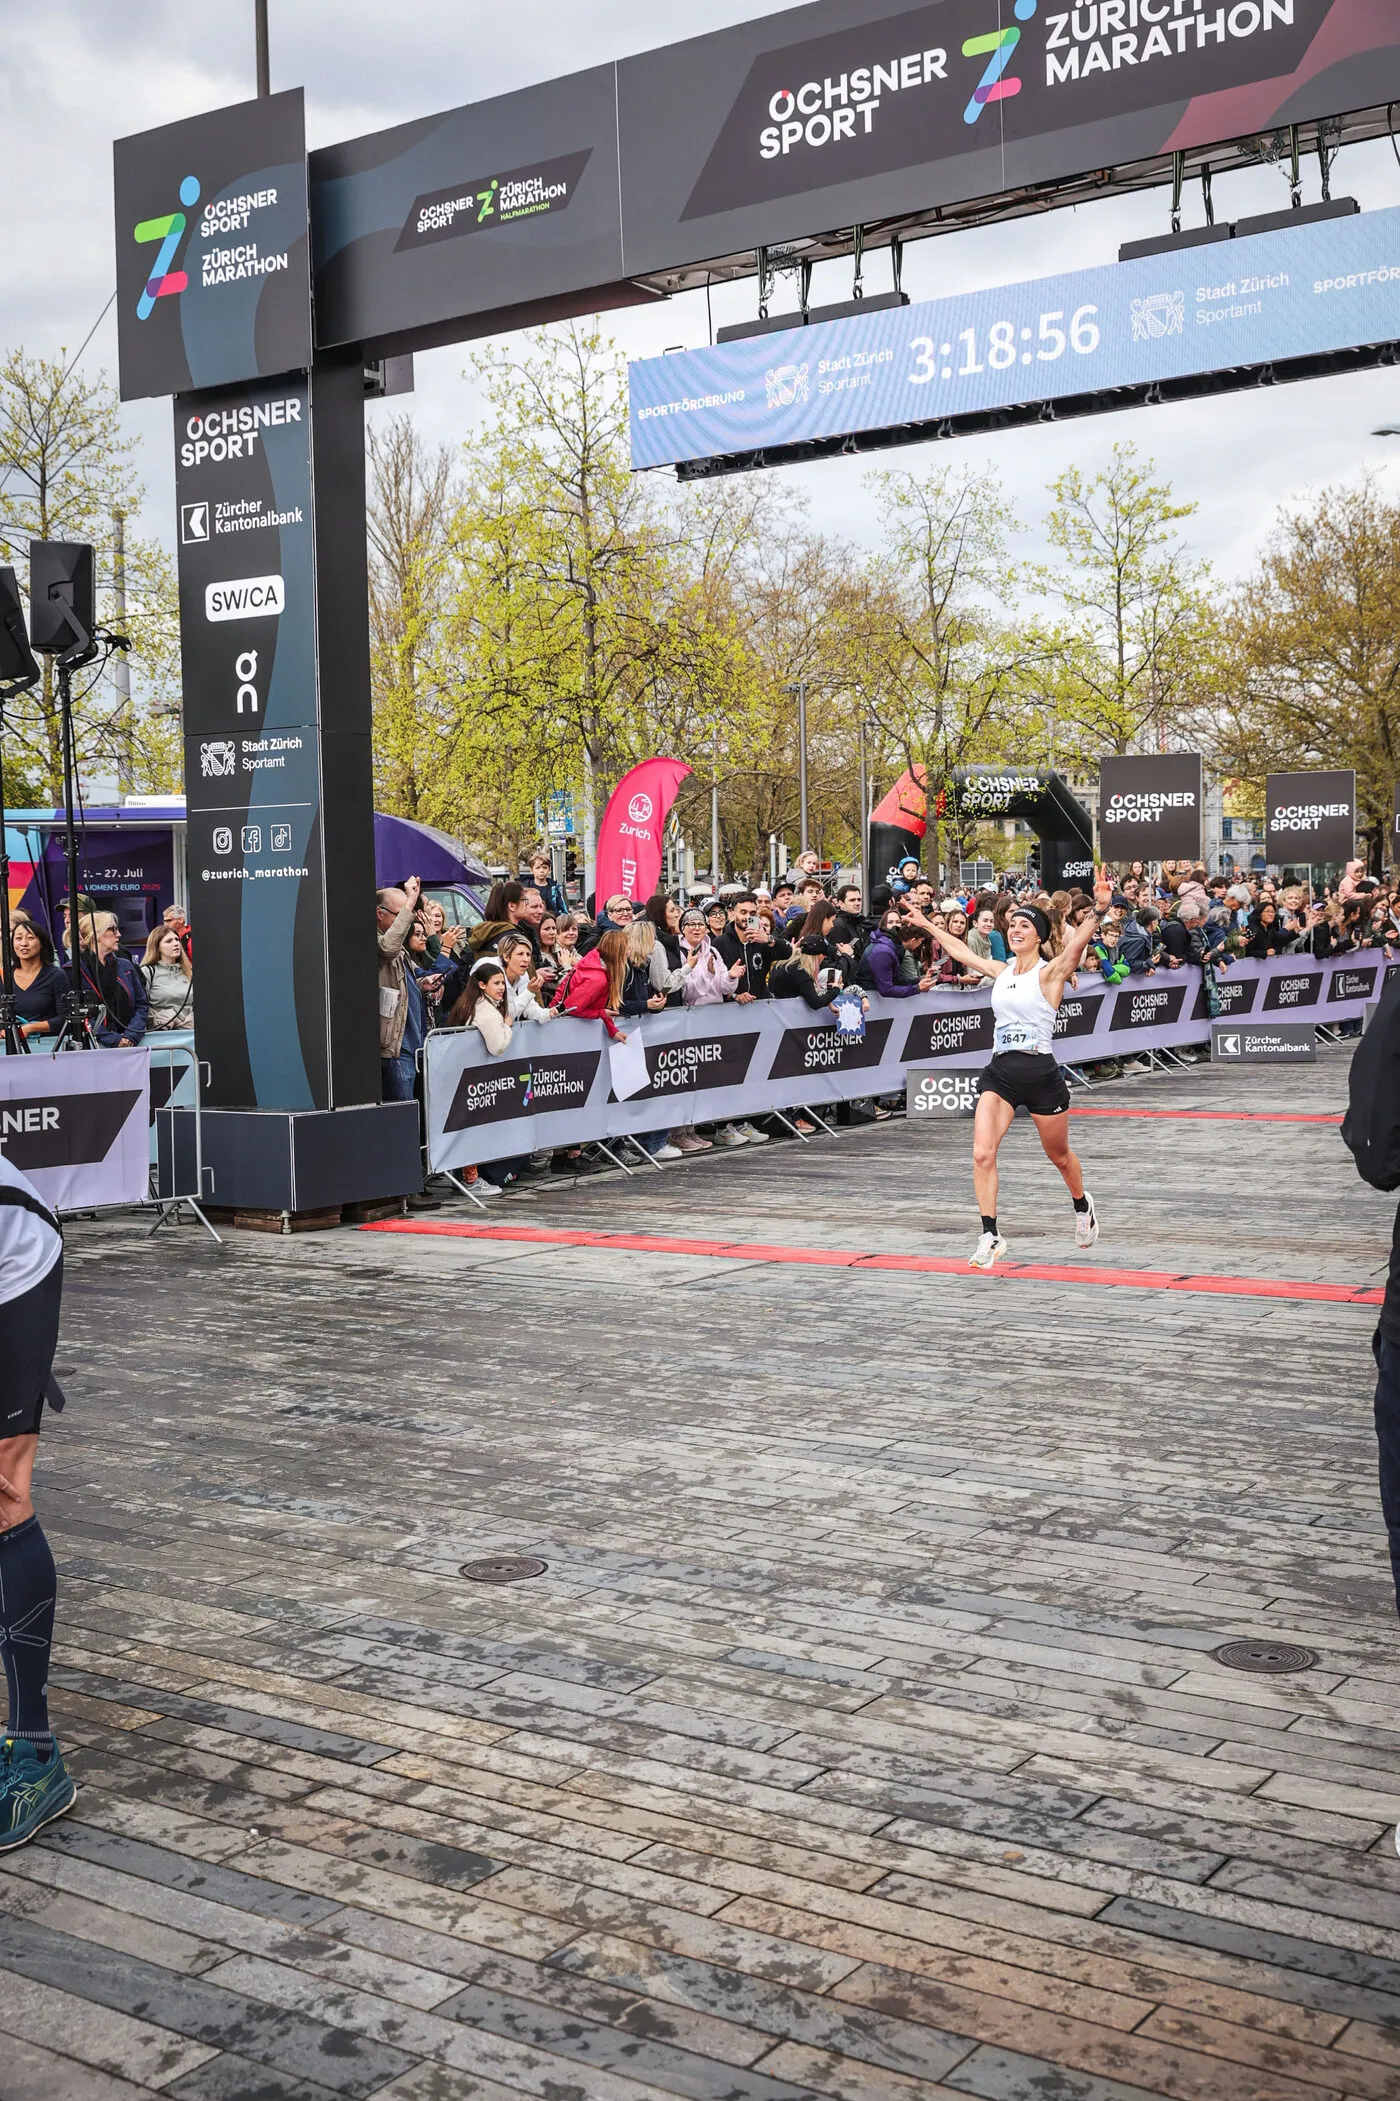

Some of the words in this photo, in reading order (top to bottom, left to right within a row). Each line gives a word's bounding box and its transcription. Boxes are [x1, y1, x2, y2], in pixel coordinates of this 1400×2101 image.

[1046, 0, 1294, 86] MARATHON
[769, 48, 948, 122] OCHSNER
[760, 99, 880, 159] SPORT
[500, 176, 543, 200] ZÜRICH
[500, 182, 567, 211] MARATHON
[204, 188, 278, 220] OCHSNER
[420, 196, 474, 221] OCHSNER
[500, 201, 551, 221] HALFMARATHON
[201, 211, 250, 238] SPORT
[417, 212, 454, 233] SPORT
[202, 243, 257, 271] ZÜRICH
[202, 252, 288, 287] MARATHON
[1196, 281, 1237, 303] Stadt
[1239, 271, 1290, 294] Zürich
[1196, 300, 1262, 325] Sportamt
[909, 304, 1100, 384] 3:18:56
[818, 356, 852, 374] Stadt
[853, 348, 894, 369] Zürich
[818, 373, 872, 395] Sportamt
[637, 390, 746, 420] SPORTFÖRDERUNG
[186, 397, 302, 441] OCHSNER
[180, 431, 258, 467] SPORT
[215, 499, 263, 519] Zürcher
[215, 506, 304, 534] Kantonalbank
[211, 585, 279, 613] SWICA
[241, 739, 268, 753] Stadt
[269, 736, 303, 751] Zürich
[242, 755, 285, 772] Sportamt
[964, 776, 1040, 792] OCHSNER
[961, 792, 1014, 809] SPORT
[1110, 792, 1195, 809] OCHSNER
[1105, 808, 1164, 823] SPORT
[1274, 803, 1350, 820] OCHSNER
[1270, 818, 1322, 832] SPORT
[104, 869, 121, 878] 27.
[123, 868, 144, 878] Juli
[201, 865, 309, 881] @zuerich_marathon
[1062, 869, 1091, 878] SPORT
[1217, 985, 1243, 999] CHSNER
[1281, 978, 1310, 992] OCHSNER
[1132, 992, 1168, 1009] OCHSNER
[1279, 991, 1300, 1004] SPORT
[1057, 1002, 1083, 1019] SNER
[1130, 1007, 1156, 1023] SPORT
[932, 1014, 981, 1035] OCHSNER
[1052, 1019, 1069, 1034] ORT
[930, 1032, 964, 1051] SPORT
[1002, 1033, 1027, 1044] 2647
[1245, 1036, 1282, 1045] Zürcher
[1245, 1043, 1311, 1053] Kantonalbank
[658, 1043, 722, 1069] OCHSNER
[804, 1047, 843, 1068] SPORT
[467, 1076, 516, 1097] OCHSNER
[532, 1068, 566, 1086] ZÜRICH
[653, 1065, 698, 1089] SPORT
[920, 1076, 980, 1094] OCHS
[533, 1080, 584, 1098] MARATHON
[466, 1093, 497, 1111] SPORT
[0, 1106, 60, 1134] NER
